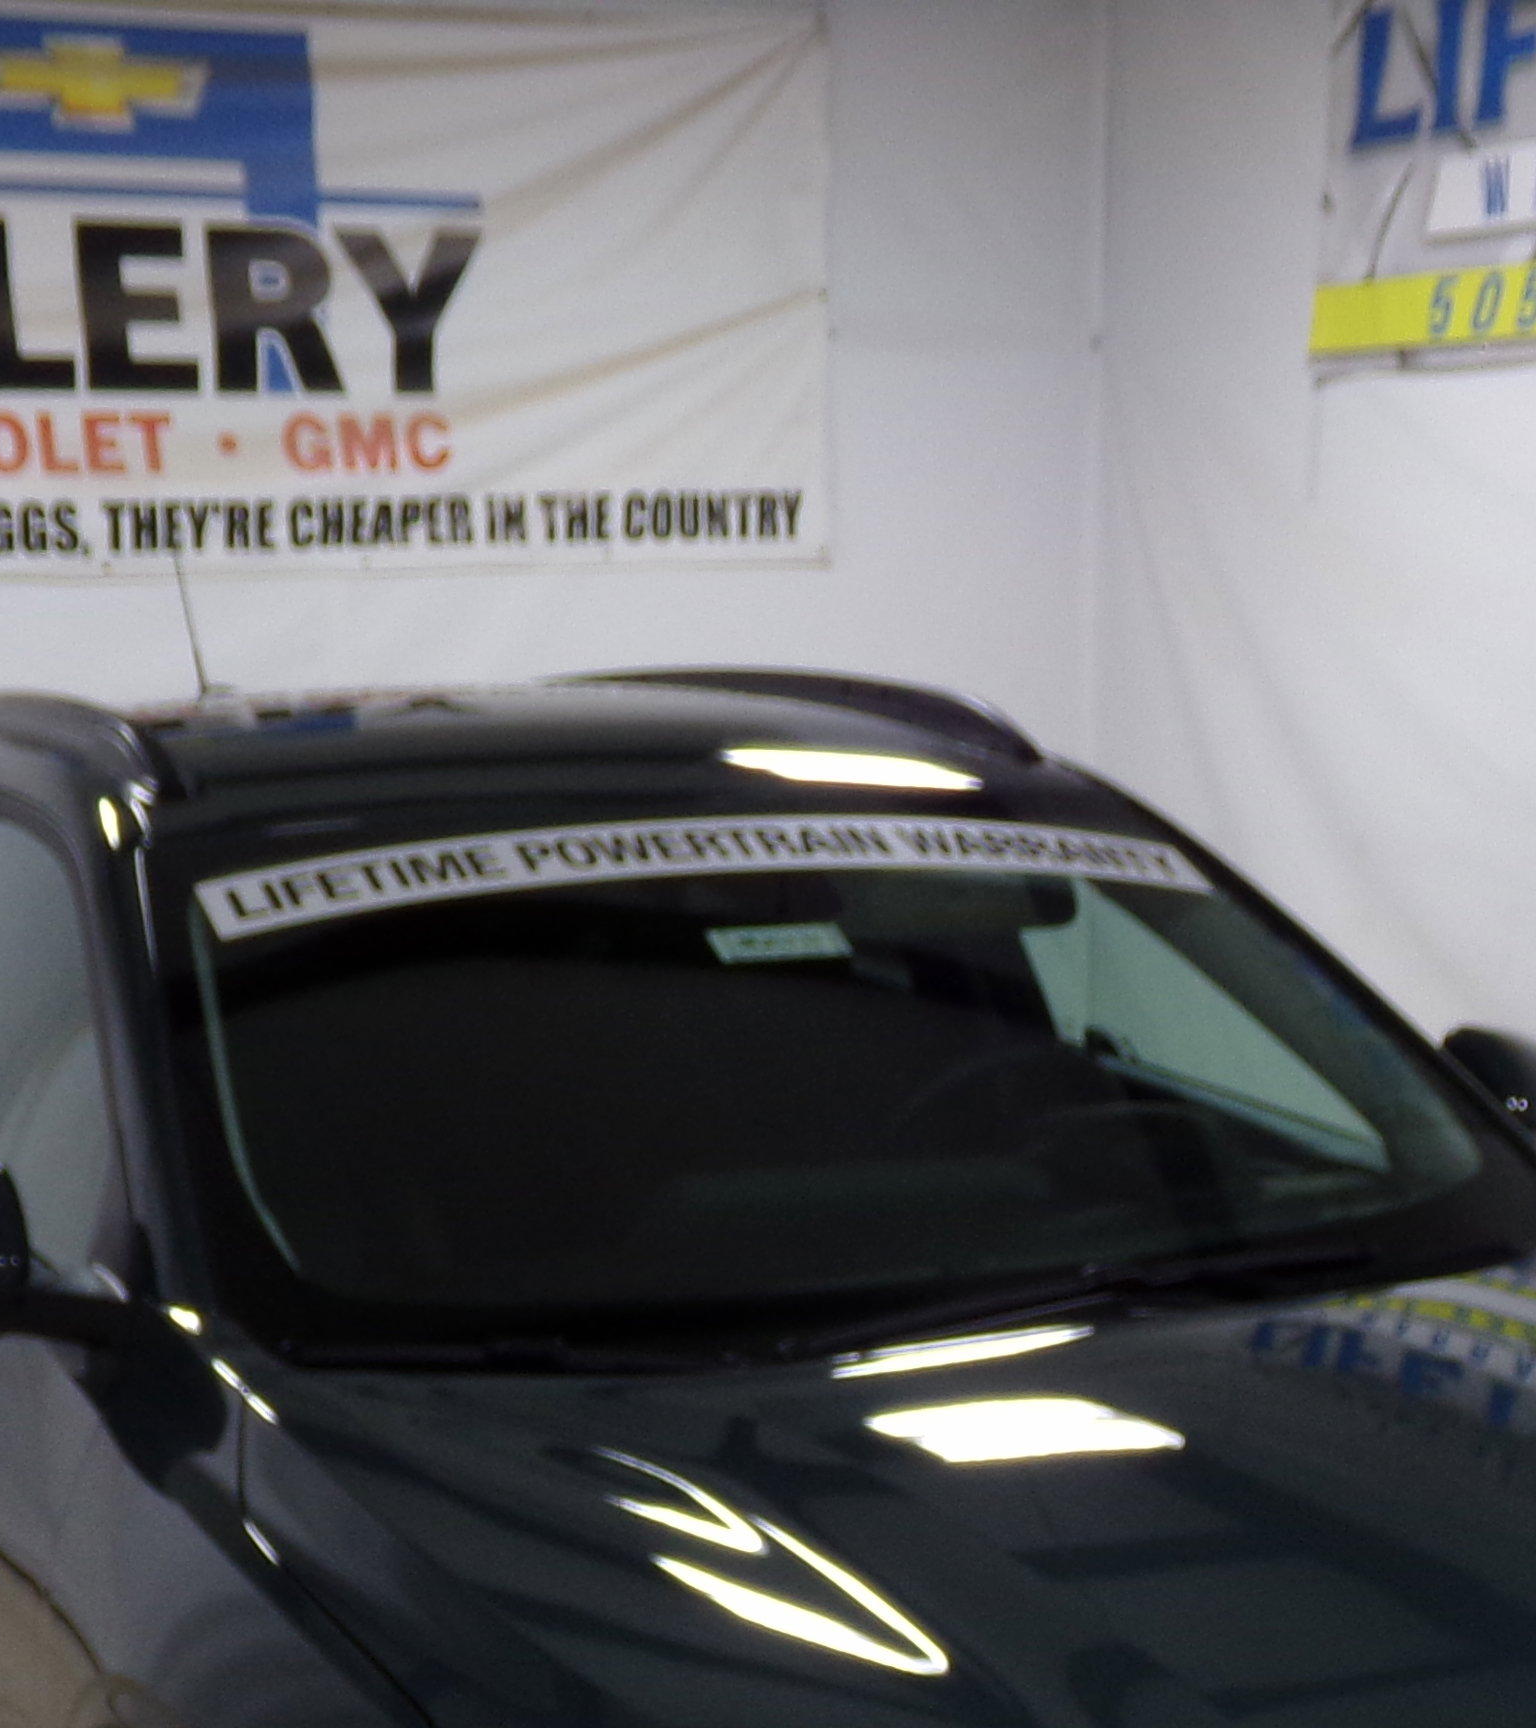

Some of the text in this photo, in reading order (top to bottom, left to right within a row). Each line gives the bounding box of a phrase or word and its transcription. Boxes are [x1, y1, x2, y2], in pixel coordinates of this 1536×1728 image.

[282, 408, 453, 473] GMC
[102, 500, 275, 553] THEY'RE
[289, 497, 474, 549] CHEAPER
[484, 494, 529, 543] IN
[538, 492, 611, 542] THE
[624, 488, 805, 542] COUNTRY
[224, 825, 1177, 921] LIFETIME POWERTRAIN WARRANTY
